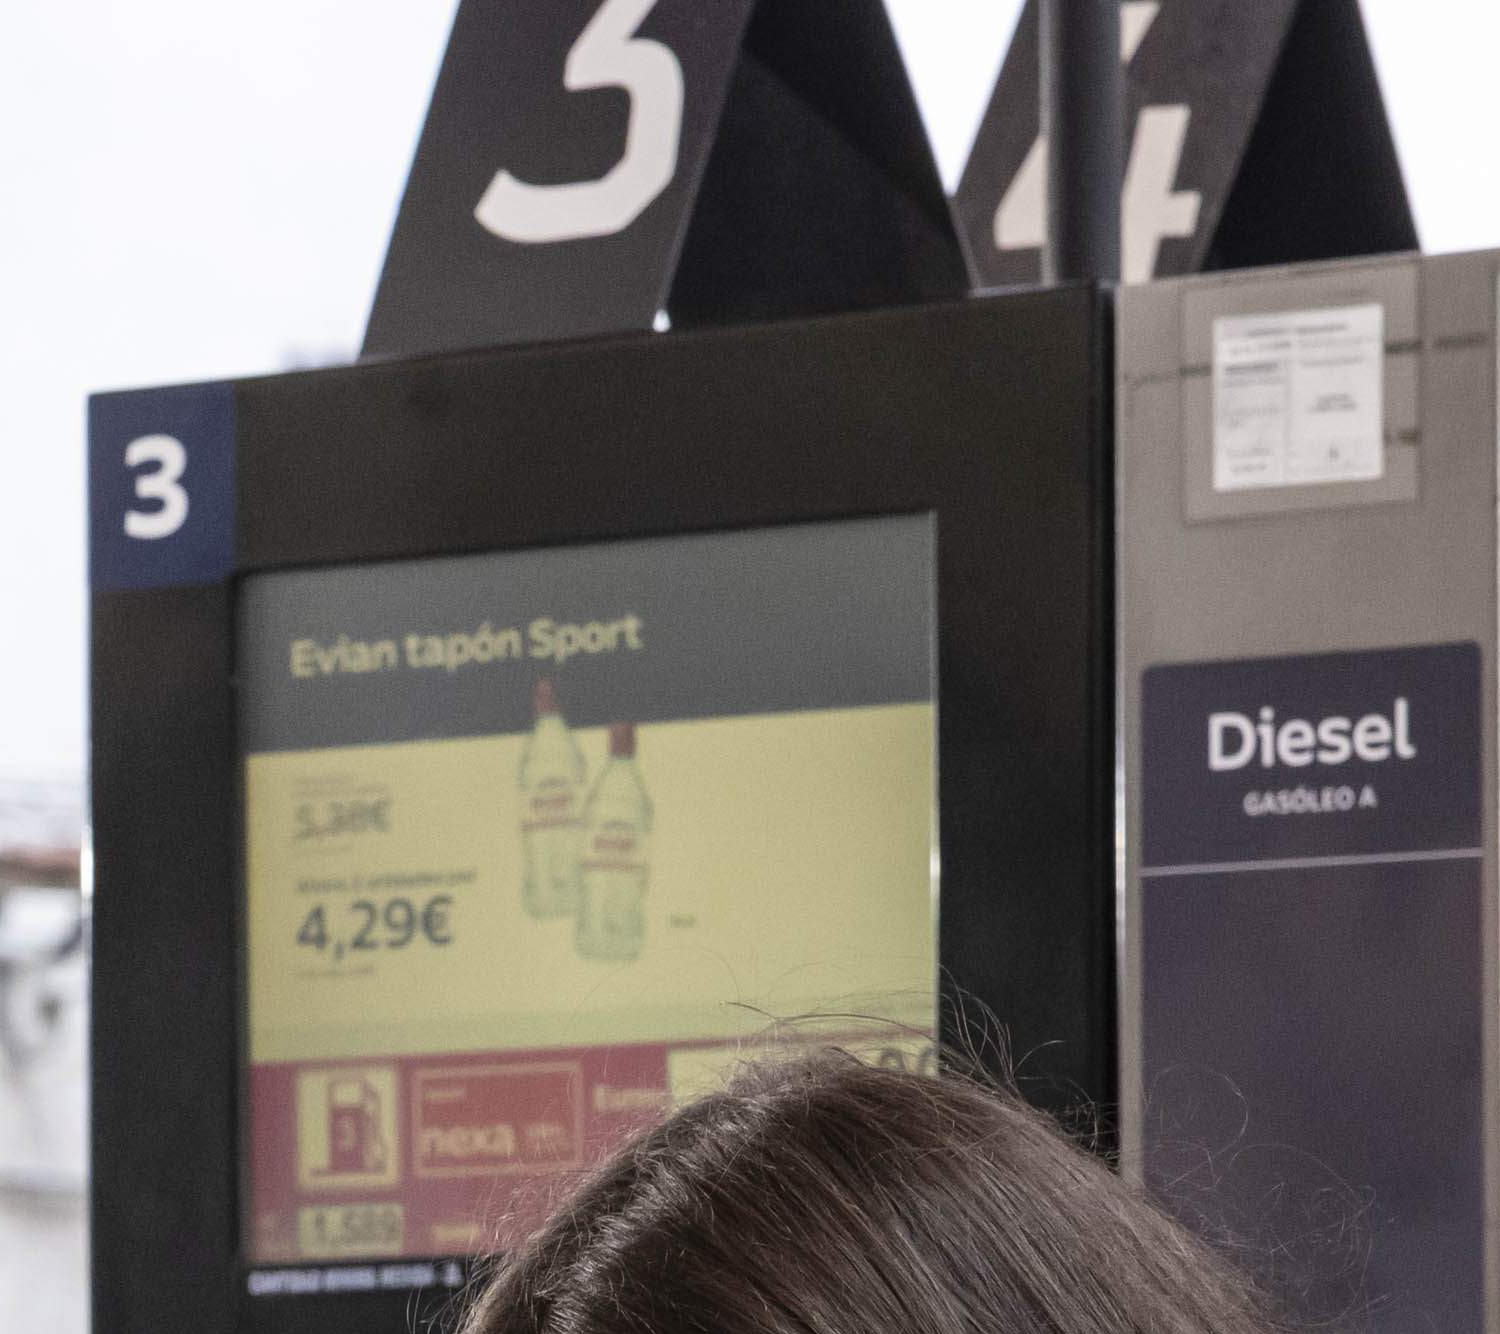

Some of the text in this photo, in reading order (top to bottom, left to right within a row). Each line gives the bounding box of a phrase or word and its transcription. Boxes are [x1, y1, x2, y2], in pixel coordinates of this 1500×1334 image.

[472, 0, 686, 244] 3
[123, 435, 189, 540] 3
[290, 612, 645, 678] Evian tapón Sport
[1206, 696, 1417, 773] Diesel
[1243, 785, 1378, 818] GASÓLEO A
[295, 893, 455, 962] 4,29€
